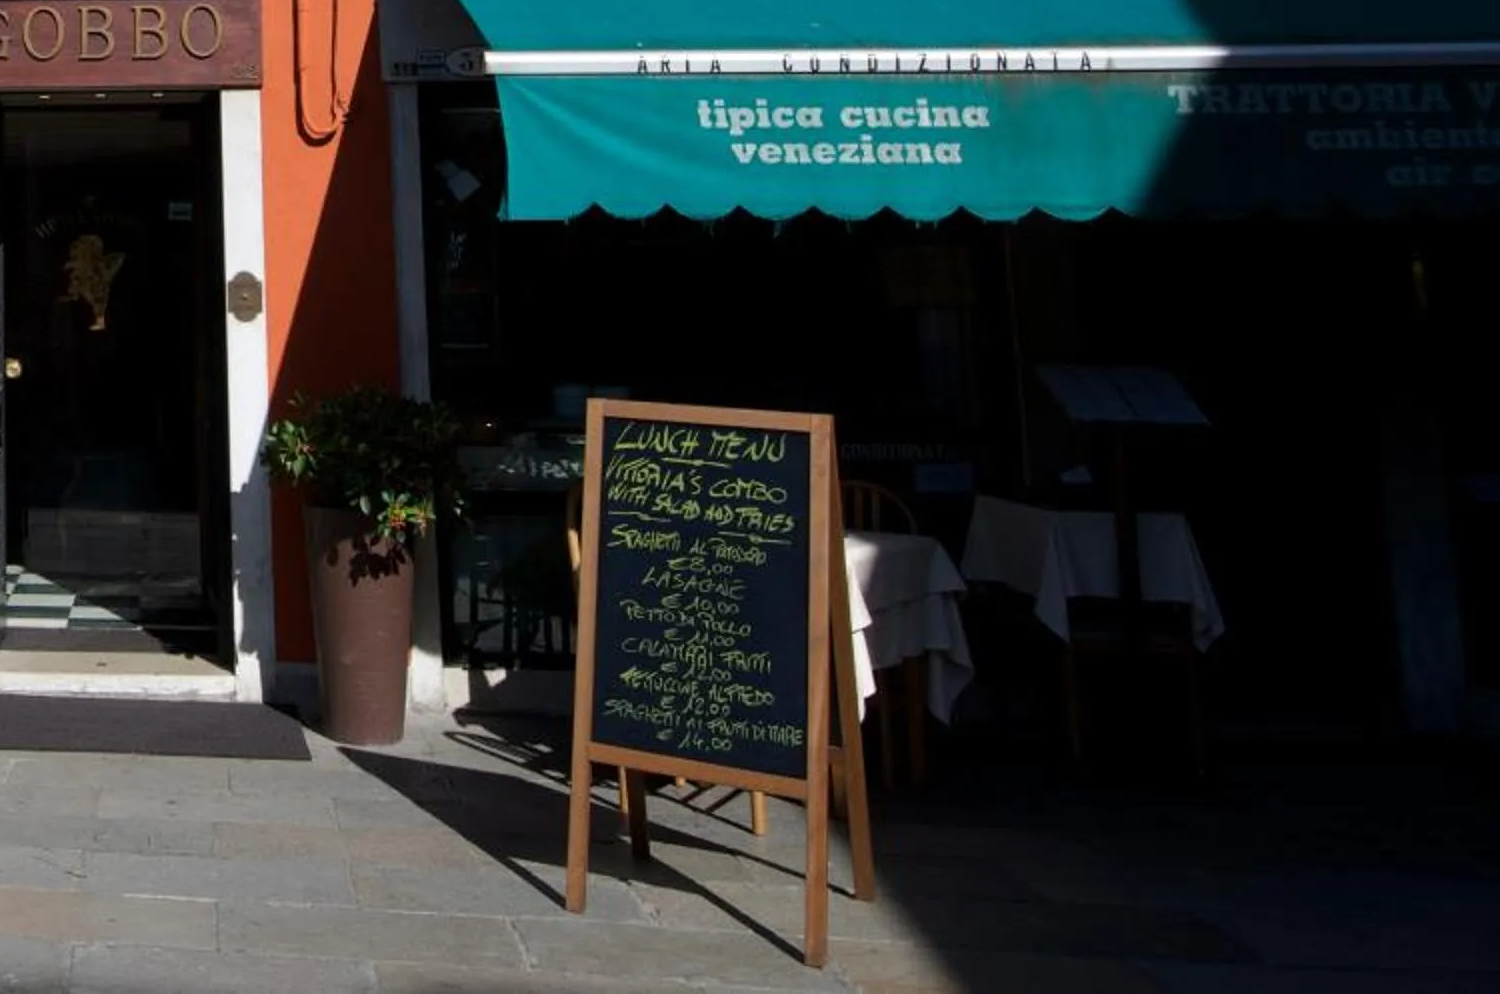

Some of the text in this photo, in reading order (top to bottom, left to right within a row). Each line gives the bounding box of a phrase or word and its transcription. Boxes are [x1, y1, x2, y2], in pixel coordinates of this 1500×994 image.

[636, 51, 1093, 75] ARIA CONDIZIONATA
[1168, 80, 1454, 116] TRATTORIA
[698, 97, 991, 137] tipica cucina
[730, 134, 963, 166] veneziana
[614, 422, 787, 462] LUNCH MENU
[608, 484, 651, 505] WITH
[704, 505, 734, 526] AND
[735, 507, 796, 532] FRIES
[709, 477, 788, 504] COMBO
[642, 566, 748, 600] LASAGNE
[619, 599, 675, 621] PETTO
[698, 612, 751, 636] POLLO
